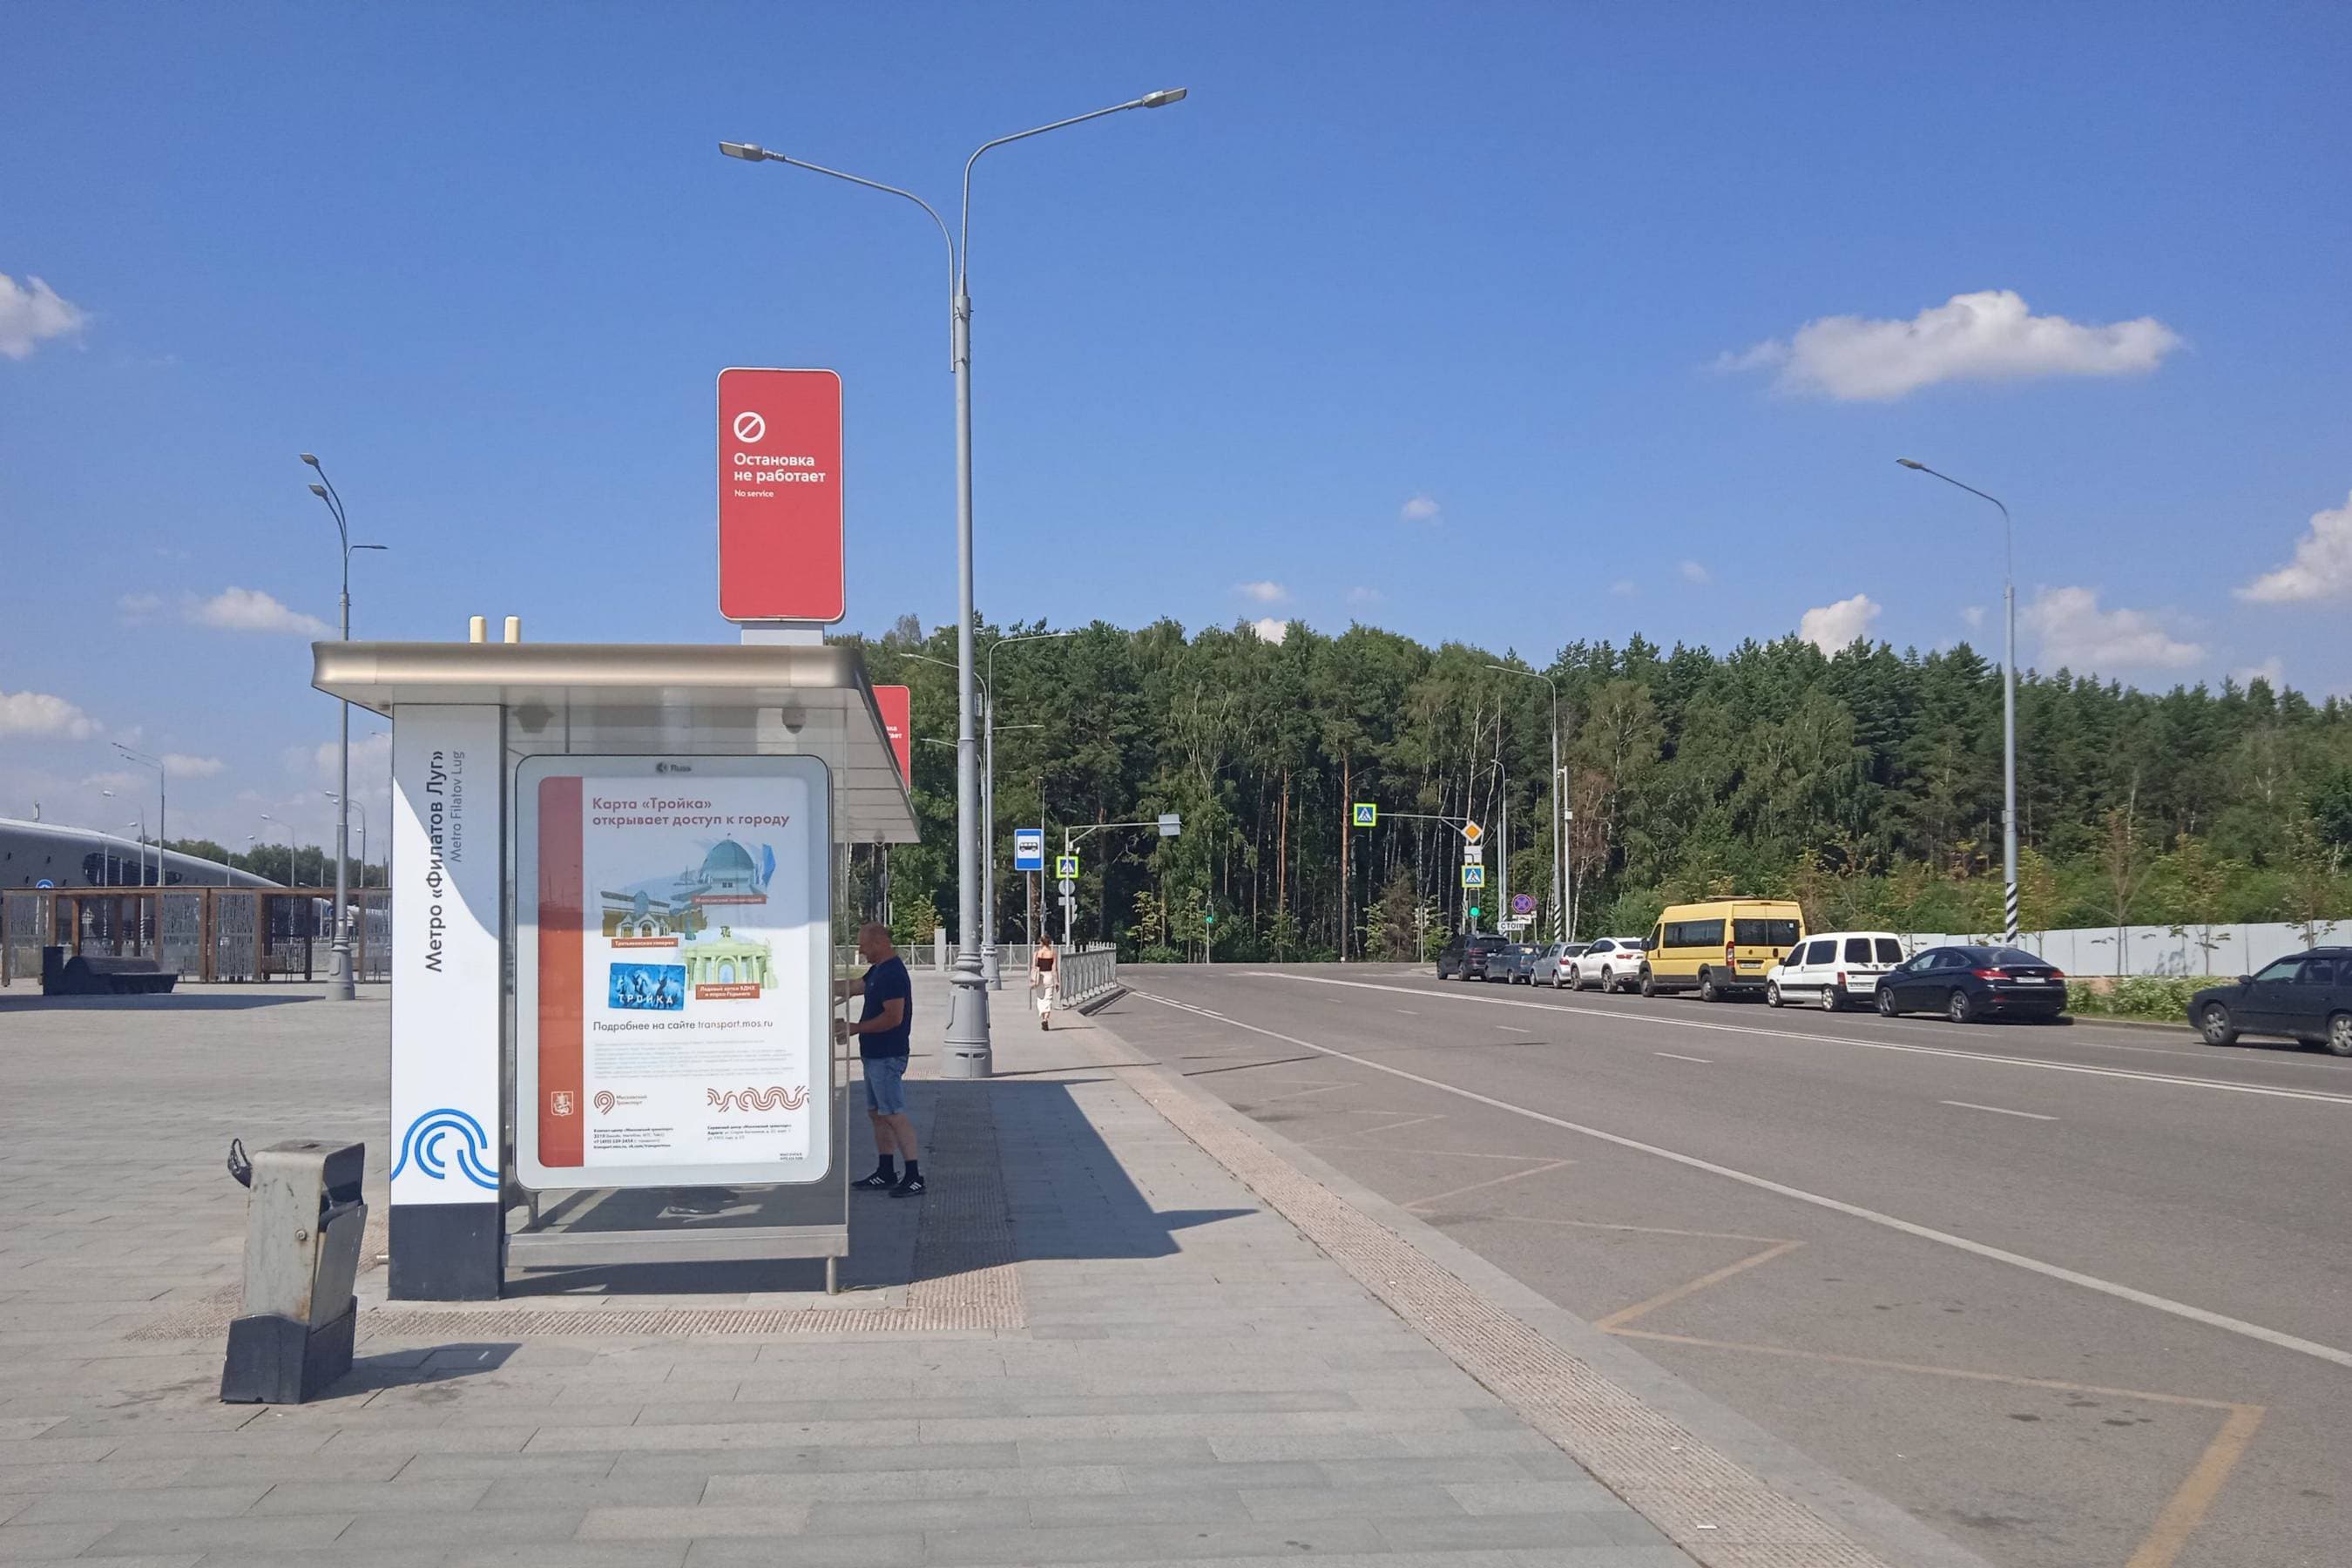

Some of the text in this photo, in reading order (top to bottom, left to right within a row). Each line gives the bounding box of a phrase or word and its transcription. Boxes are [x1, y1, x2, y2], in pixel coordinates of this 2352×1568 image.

[733, 452, 814, 467] Остановка
[733, 469, 826, 484] не работает
[450, 751, 465, 862] Metro Filatov Lug
[592, 797, 711, 812] Карта «Тройка»
[592, 814, 789, 828] открывает доступ к городу
[425, 751, 446, 973] Метро «Филатов Луг»
[618, 992, 673, 1004] ТРОЙКА
[592, 1021, 650, 1032] Подробнее
[667, 1021, 695, 1030] сайте
[698, 1020, 774, 1031] transport.mos.ru
